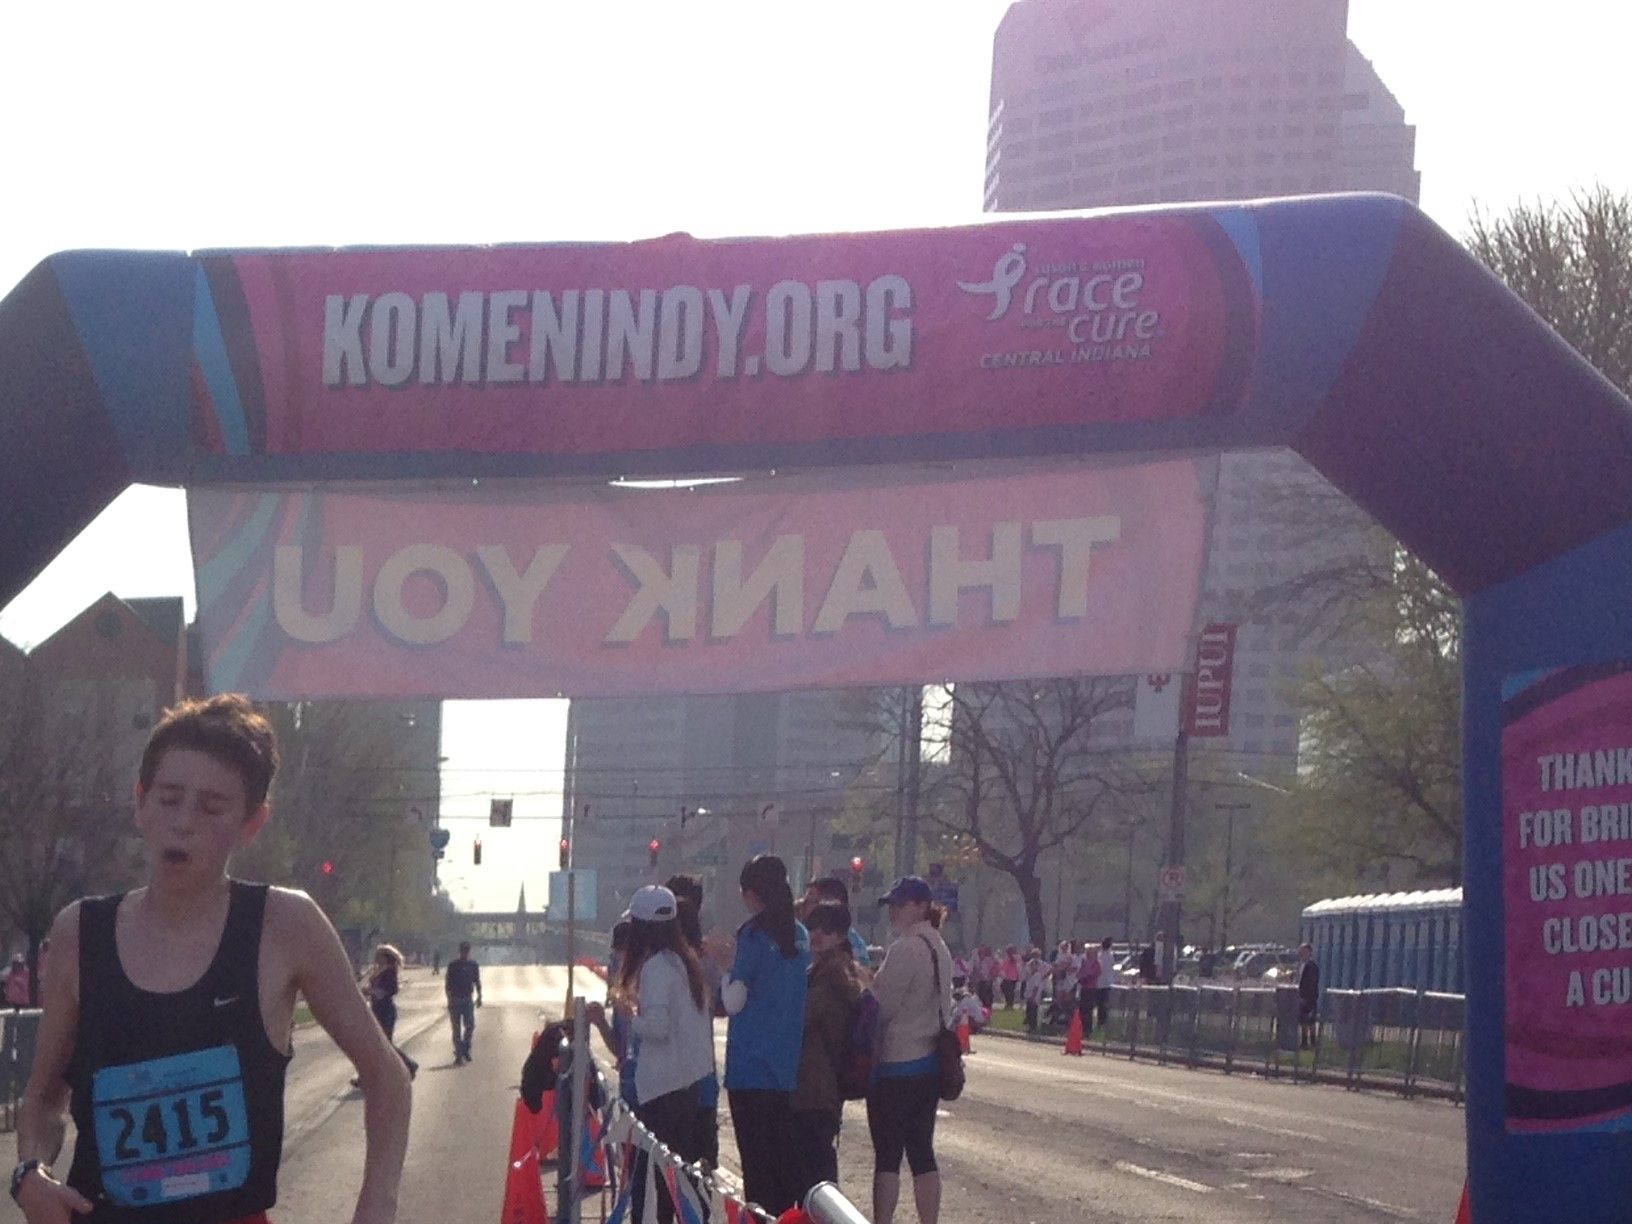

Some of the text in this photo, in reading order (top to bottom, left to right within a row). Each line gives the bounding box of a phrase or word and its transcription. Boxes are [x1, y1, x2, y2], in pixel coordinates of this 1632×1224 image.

[1023, 271, 1145, 315] race
[320, 273, 913, 386] KOMENINDY.ORG
[1068, 310, 1160, 343] cure
[979, 342, 1152, 369] CENTRAL INDIANA
[1194, 632, 1229, 730] IUPUI
[1519, 803, 1632, 849] FOR BRI
[1529, 858, 1632, 901] US ONE
[1542, 911, 1632, 954] CLOSE
[1566, 970, 1585, 1008] A
[109, 1089, 231, 1160] 2415
